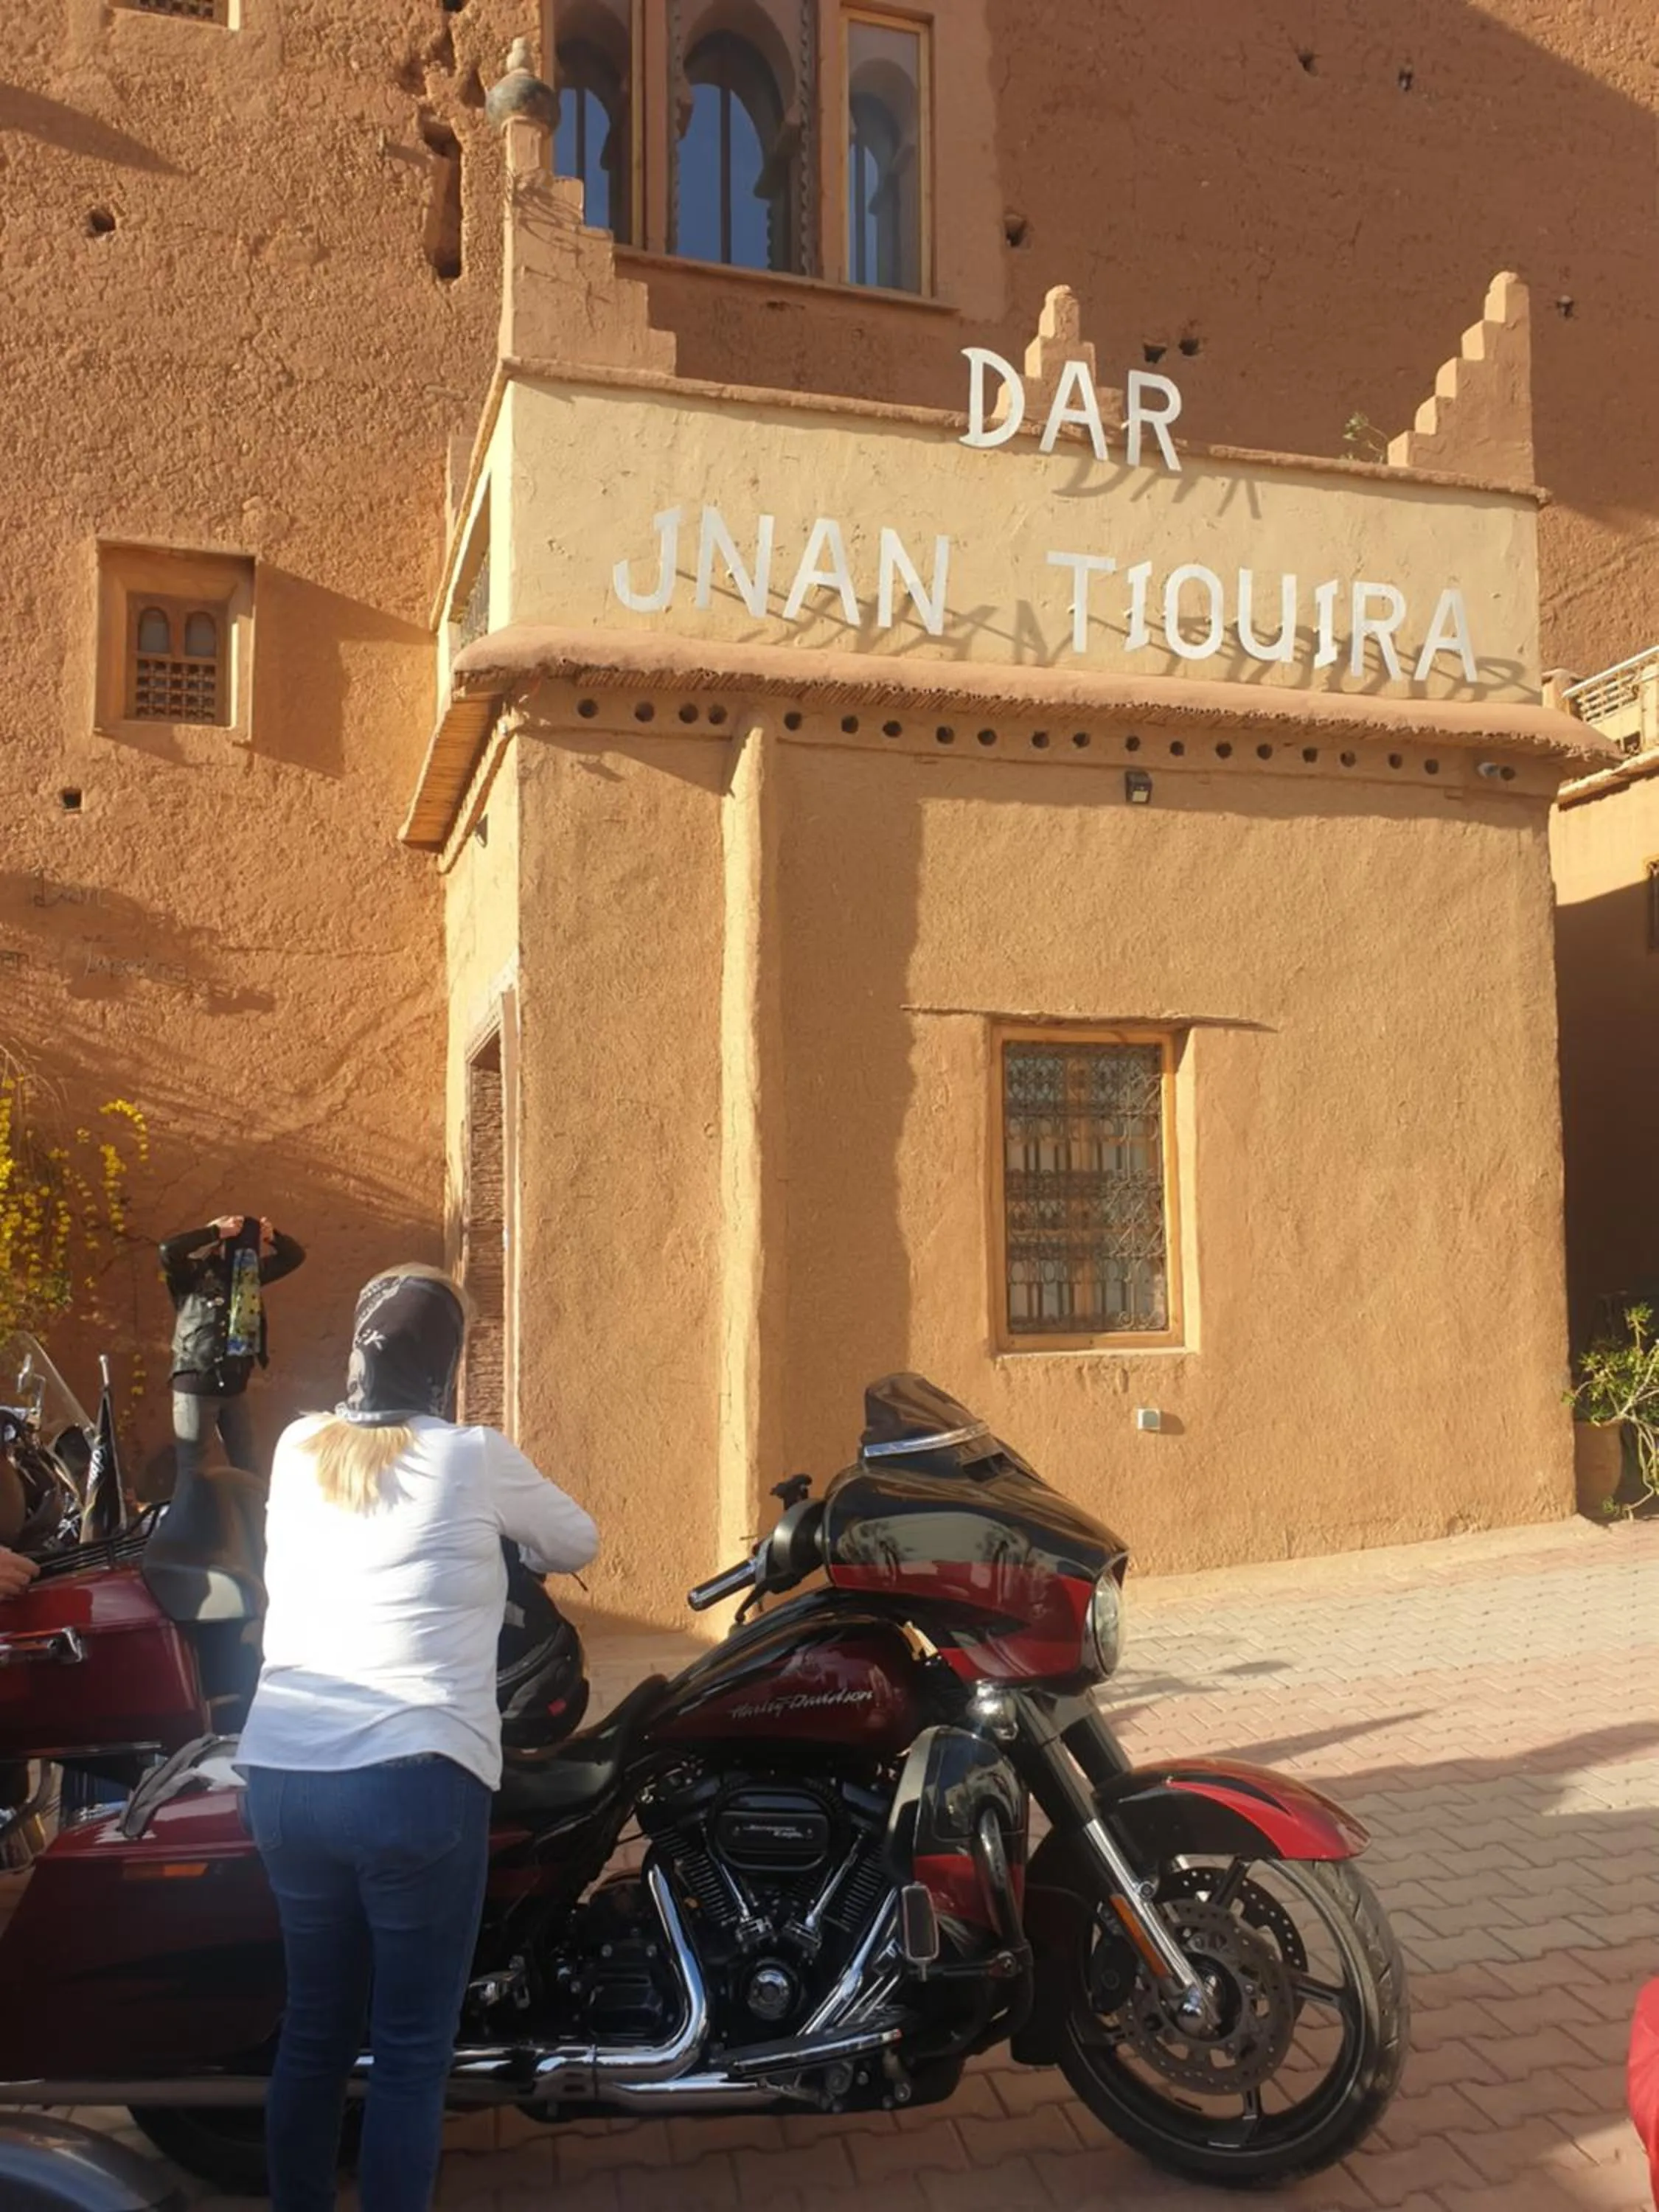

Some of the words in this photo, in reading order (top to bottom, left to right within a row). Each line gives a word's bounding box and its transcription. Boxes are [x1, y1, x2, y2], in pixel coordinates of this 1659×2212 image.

[960, 348, 1181, 470] DAR
[613, 504, 950, 636] JNAN
[1047, 552, 1477, 682] TIOUIRA
